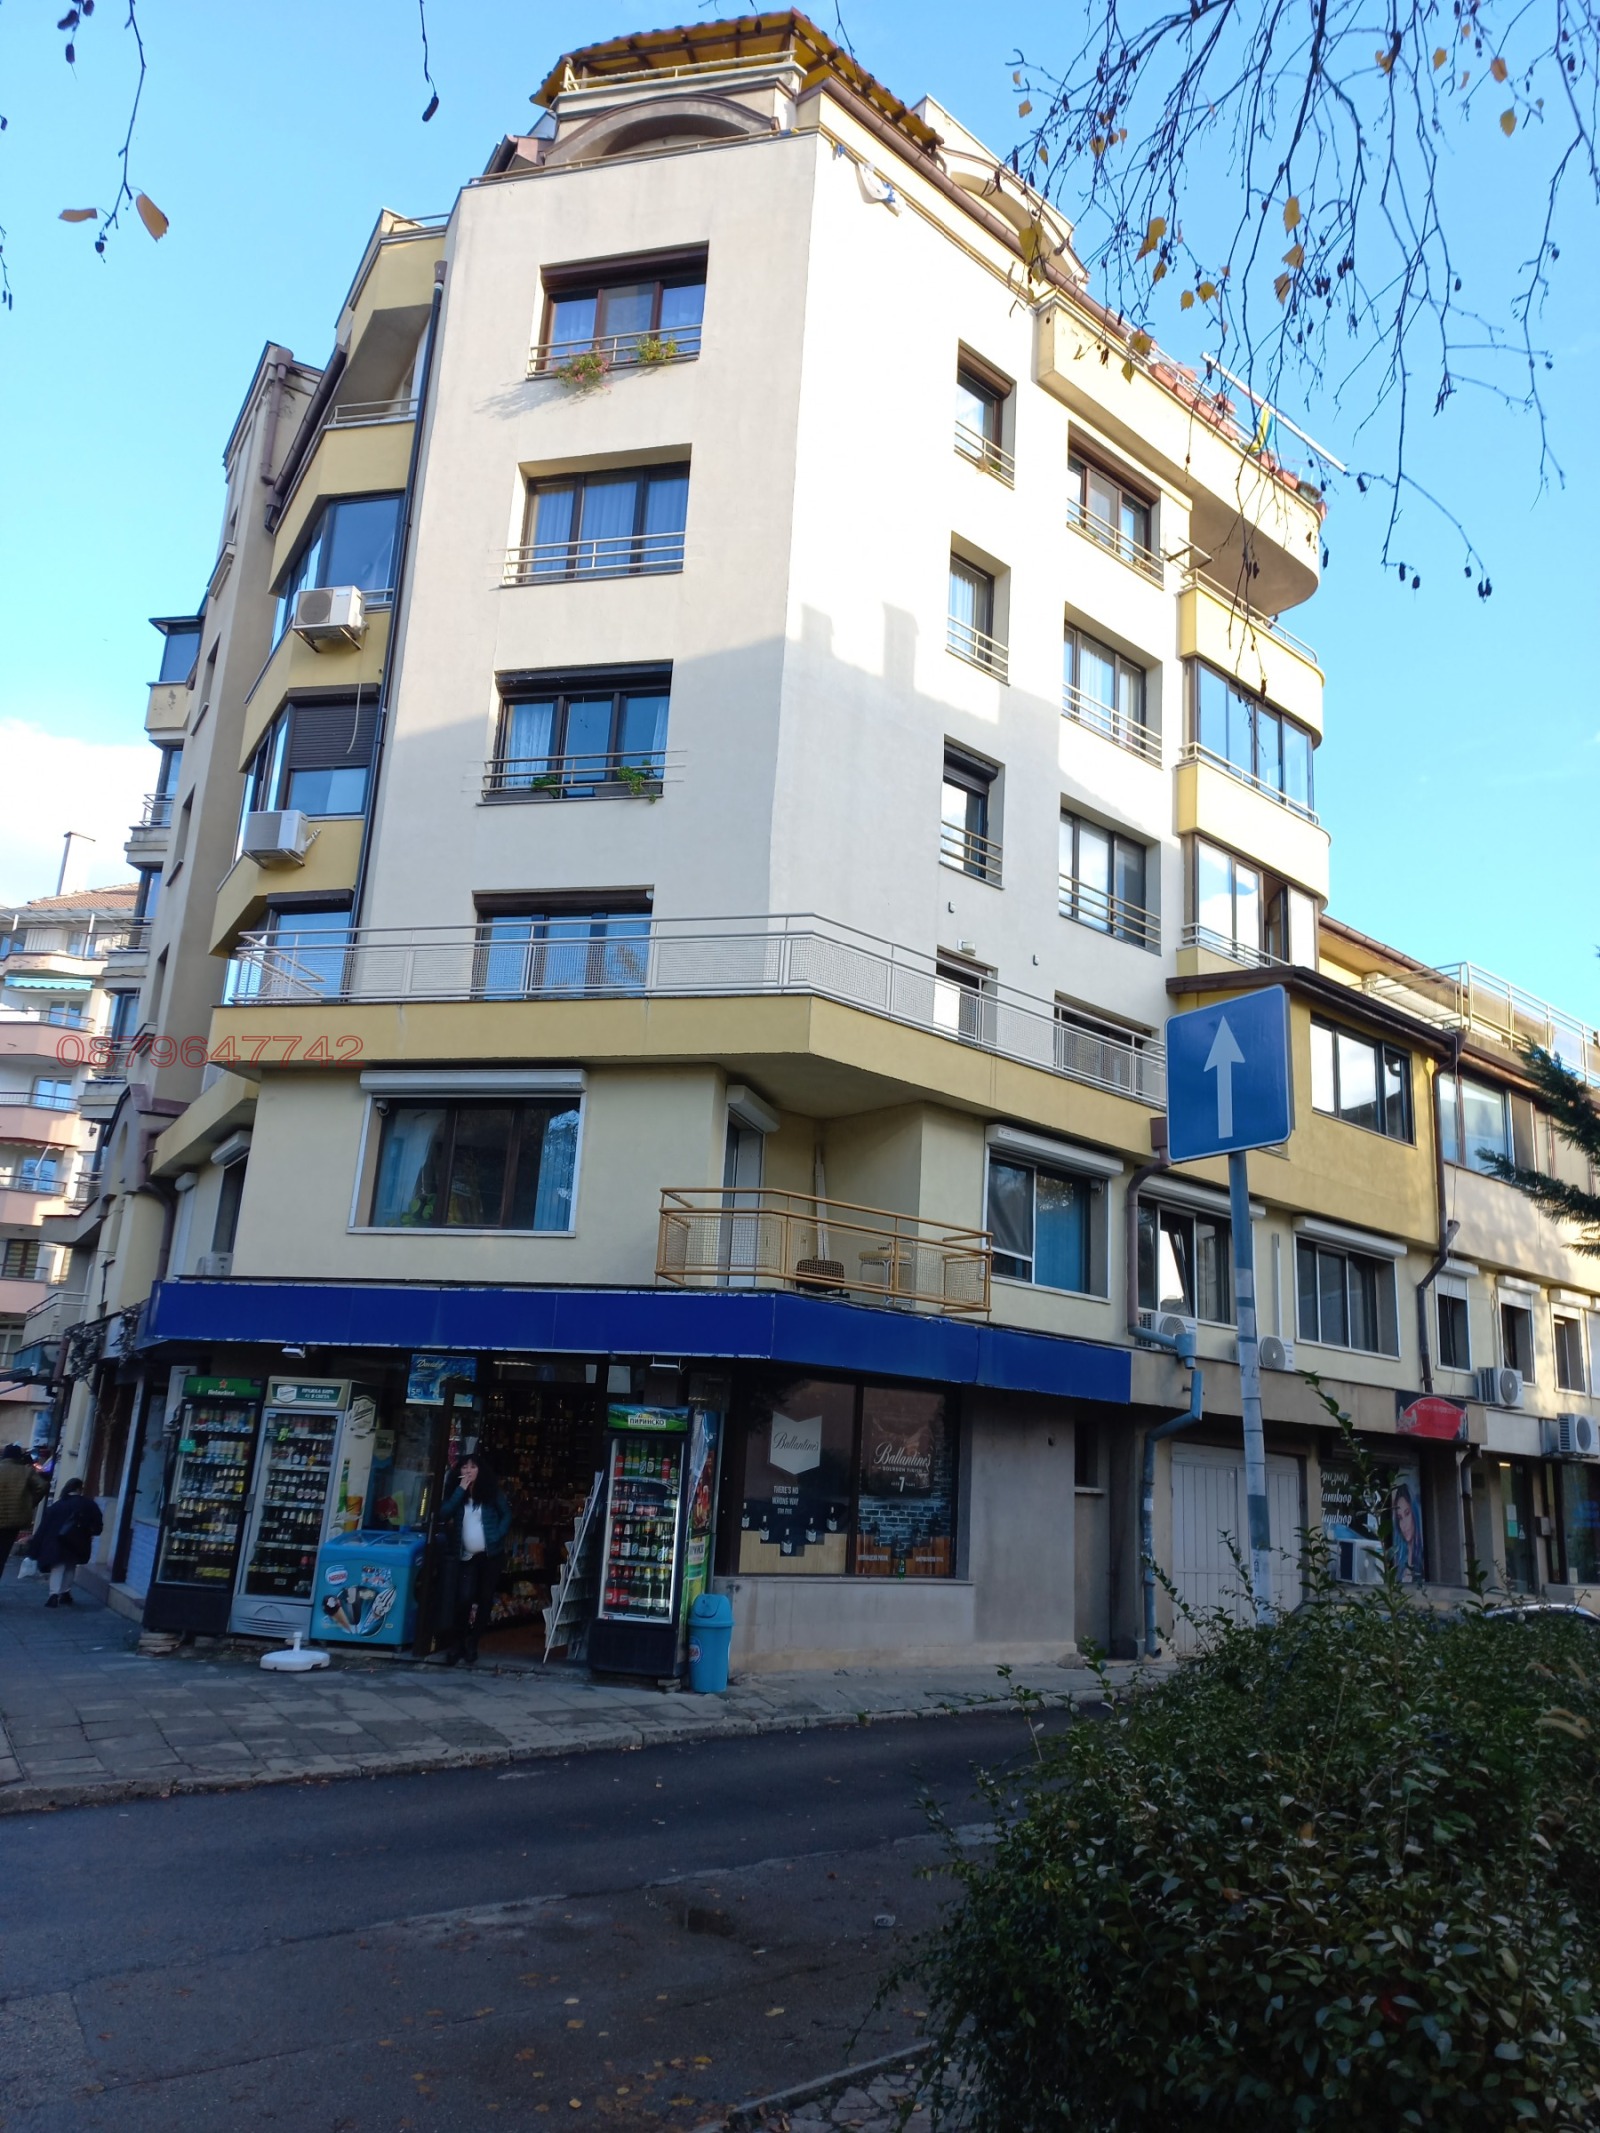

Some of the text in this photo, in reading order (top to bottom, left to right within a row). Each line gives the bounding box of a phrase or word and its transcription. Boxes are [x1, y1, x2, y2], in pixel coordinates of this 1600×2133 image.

[207, 1389, 236, 1397] Heineken
[629, 1418, 665, 1427] ПИРИНСКО
[774, 1432, 819, 1452] Ballantine's
[874, 1441, 931, 1469] Ballantine's
[773, 1485, 792, 1494] THERE'S
[899, 1476, 905, 1493] 7
